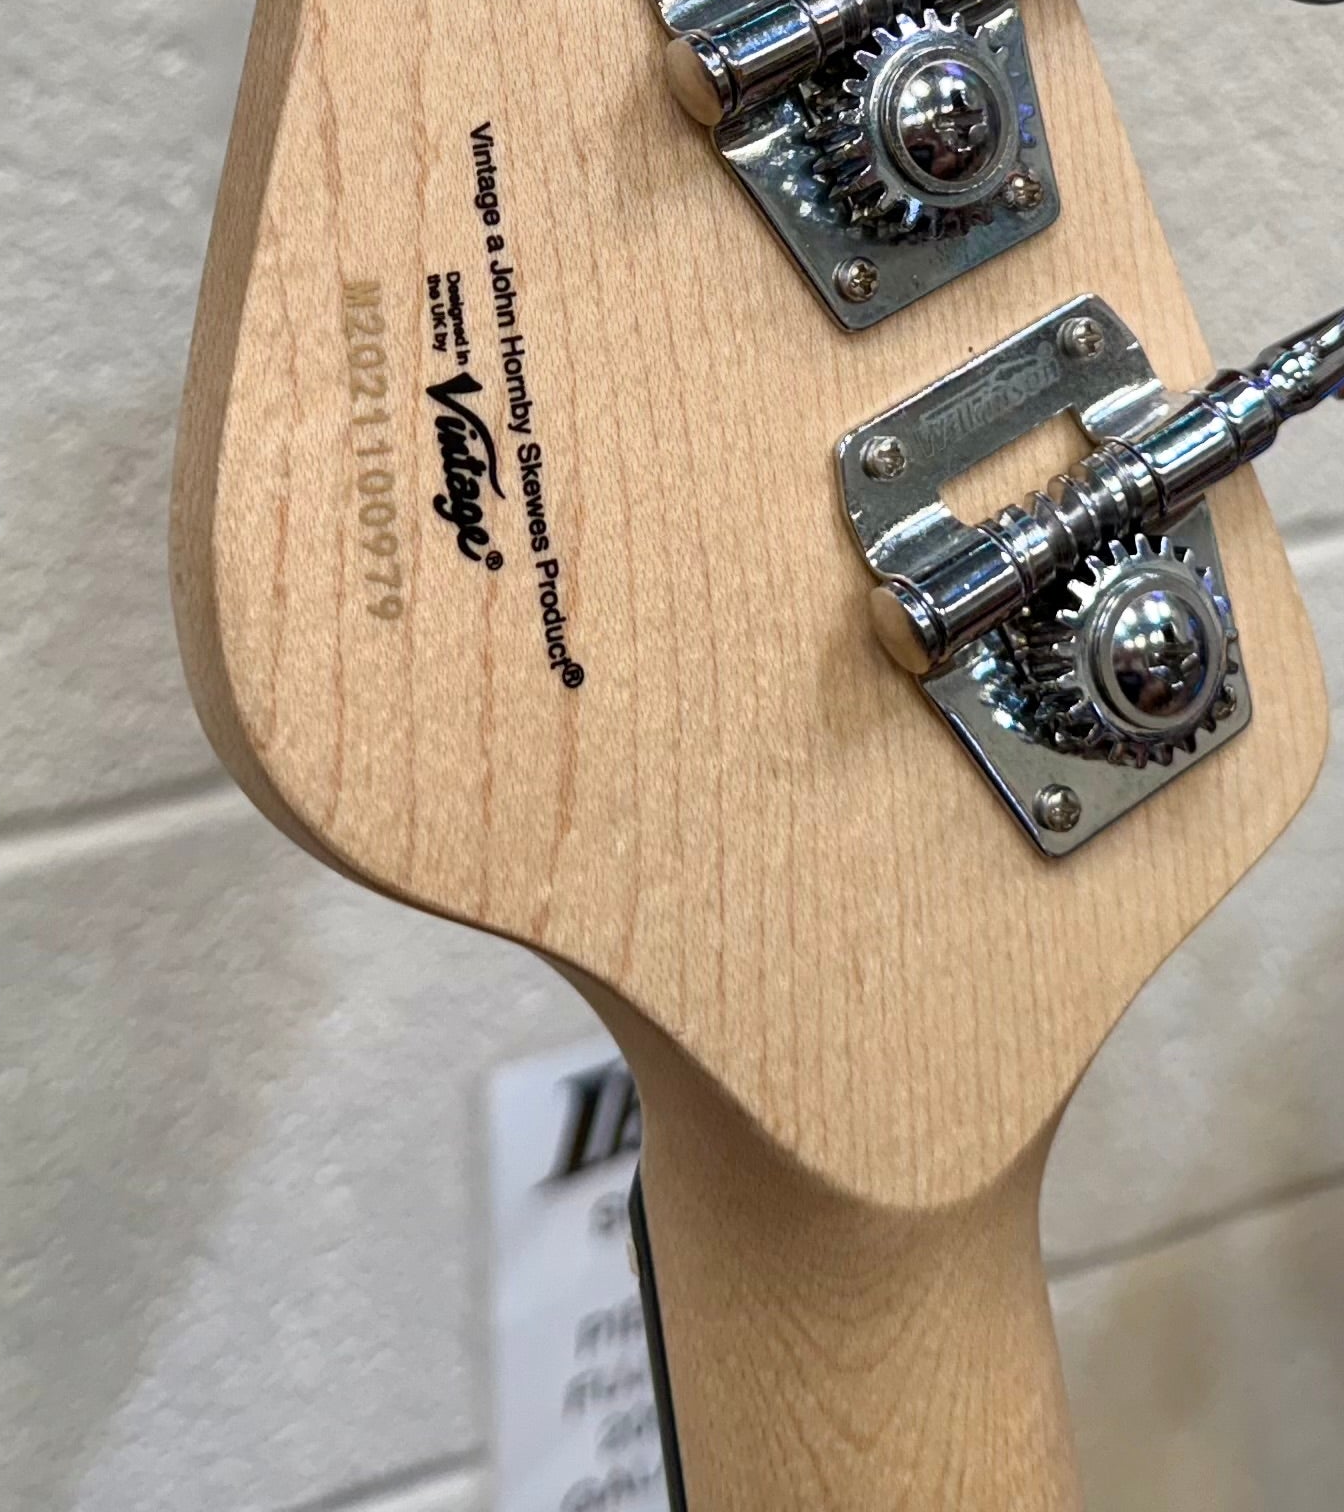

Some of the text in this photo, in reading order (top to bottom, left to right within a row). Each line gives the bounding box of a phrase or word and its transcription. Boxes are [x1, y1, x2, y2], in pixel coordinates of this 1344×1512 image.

[469, 121, 501, 227] Vintage
[485, 234, 505, 254] a
[426, 273, 449, 353] the UK by
[445, 271, 470, 348] Designed
[489, 259, 517, 329] John
[499, 334, 533, 435] Hornby
[516, 442, 550, 554] Skewes
